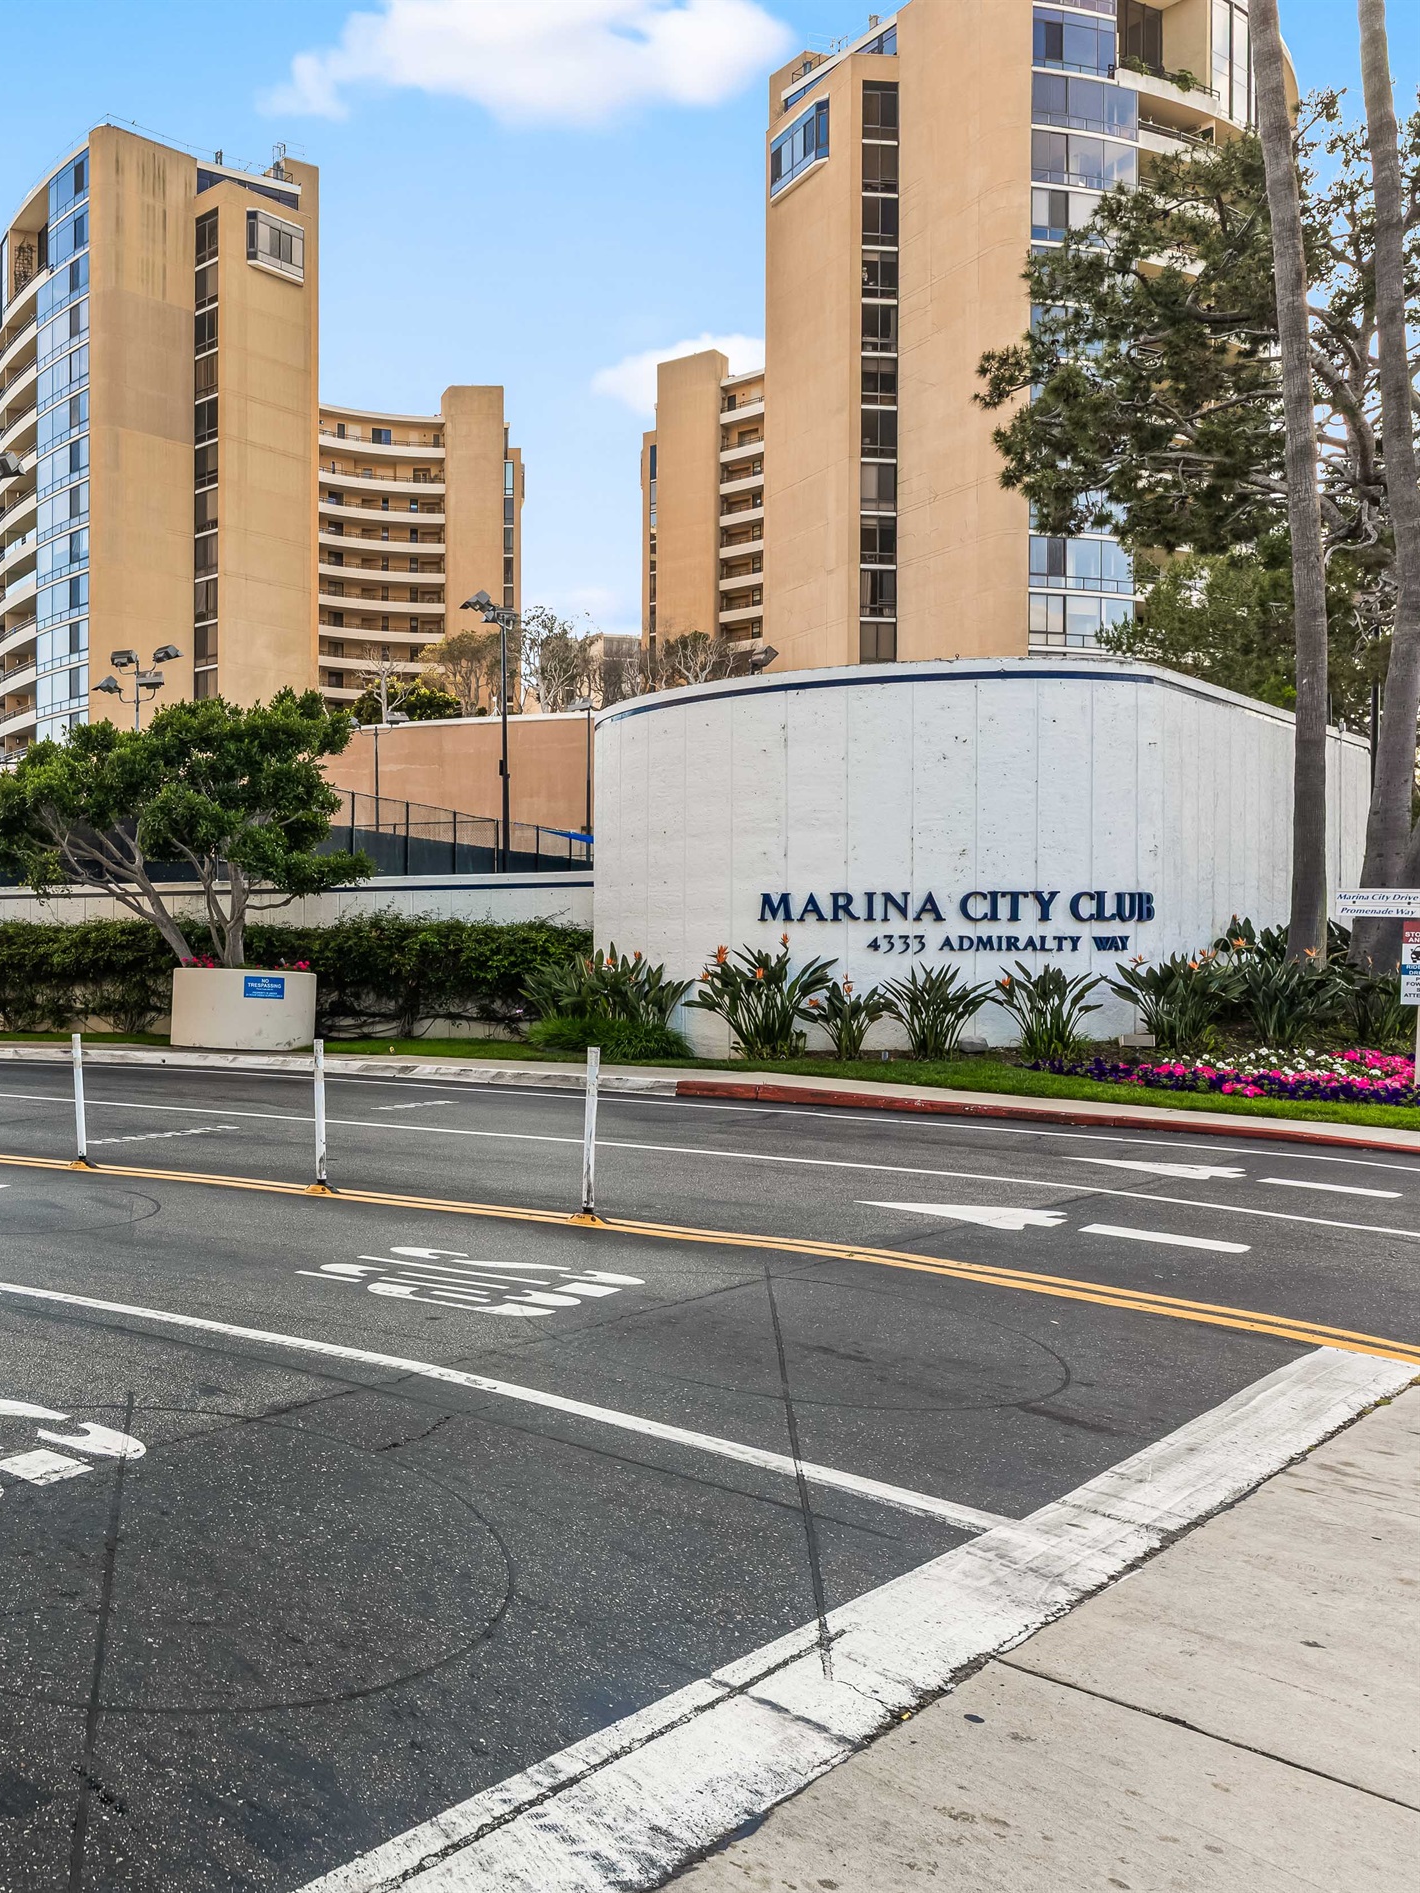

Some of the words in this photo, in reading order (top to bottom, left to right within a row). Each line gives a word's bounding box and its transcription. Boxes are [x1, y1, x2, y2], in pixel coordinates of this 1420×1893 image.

[1371, 893, 1391, 902] City
[1392, 893, 1419, 901] Drive
[757, 890, 947, 923] MARINA
[959, 890, 1061, 923] CITY
[1069, 890, 1156, 923] CLUB
[1340, 907, 1394, 915] Promenade
[1396, 908, 1416, 916] Way
[867, 934, 927, 955] 4333
[938, 935, 1081, 953] ADMIRALTY
[1091, 935, 1131, 952] WAY
